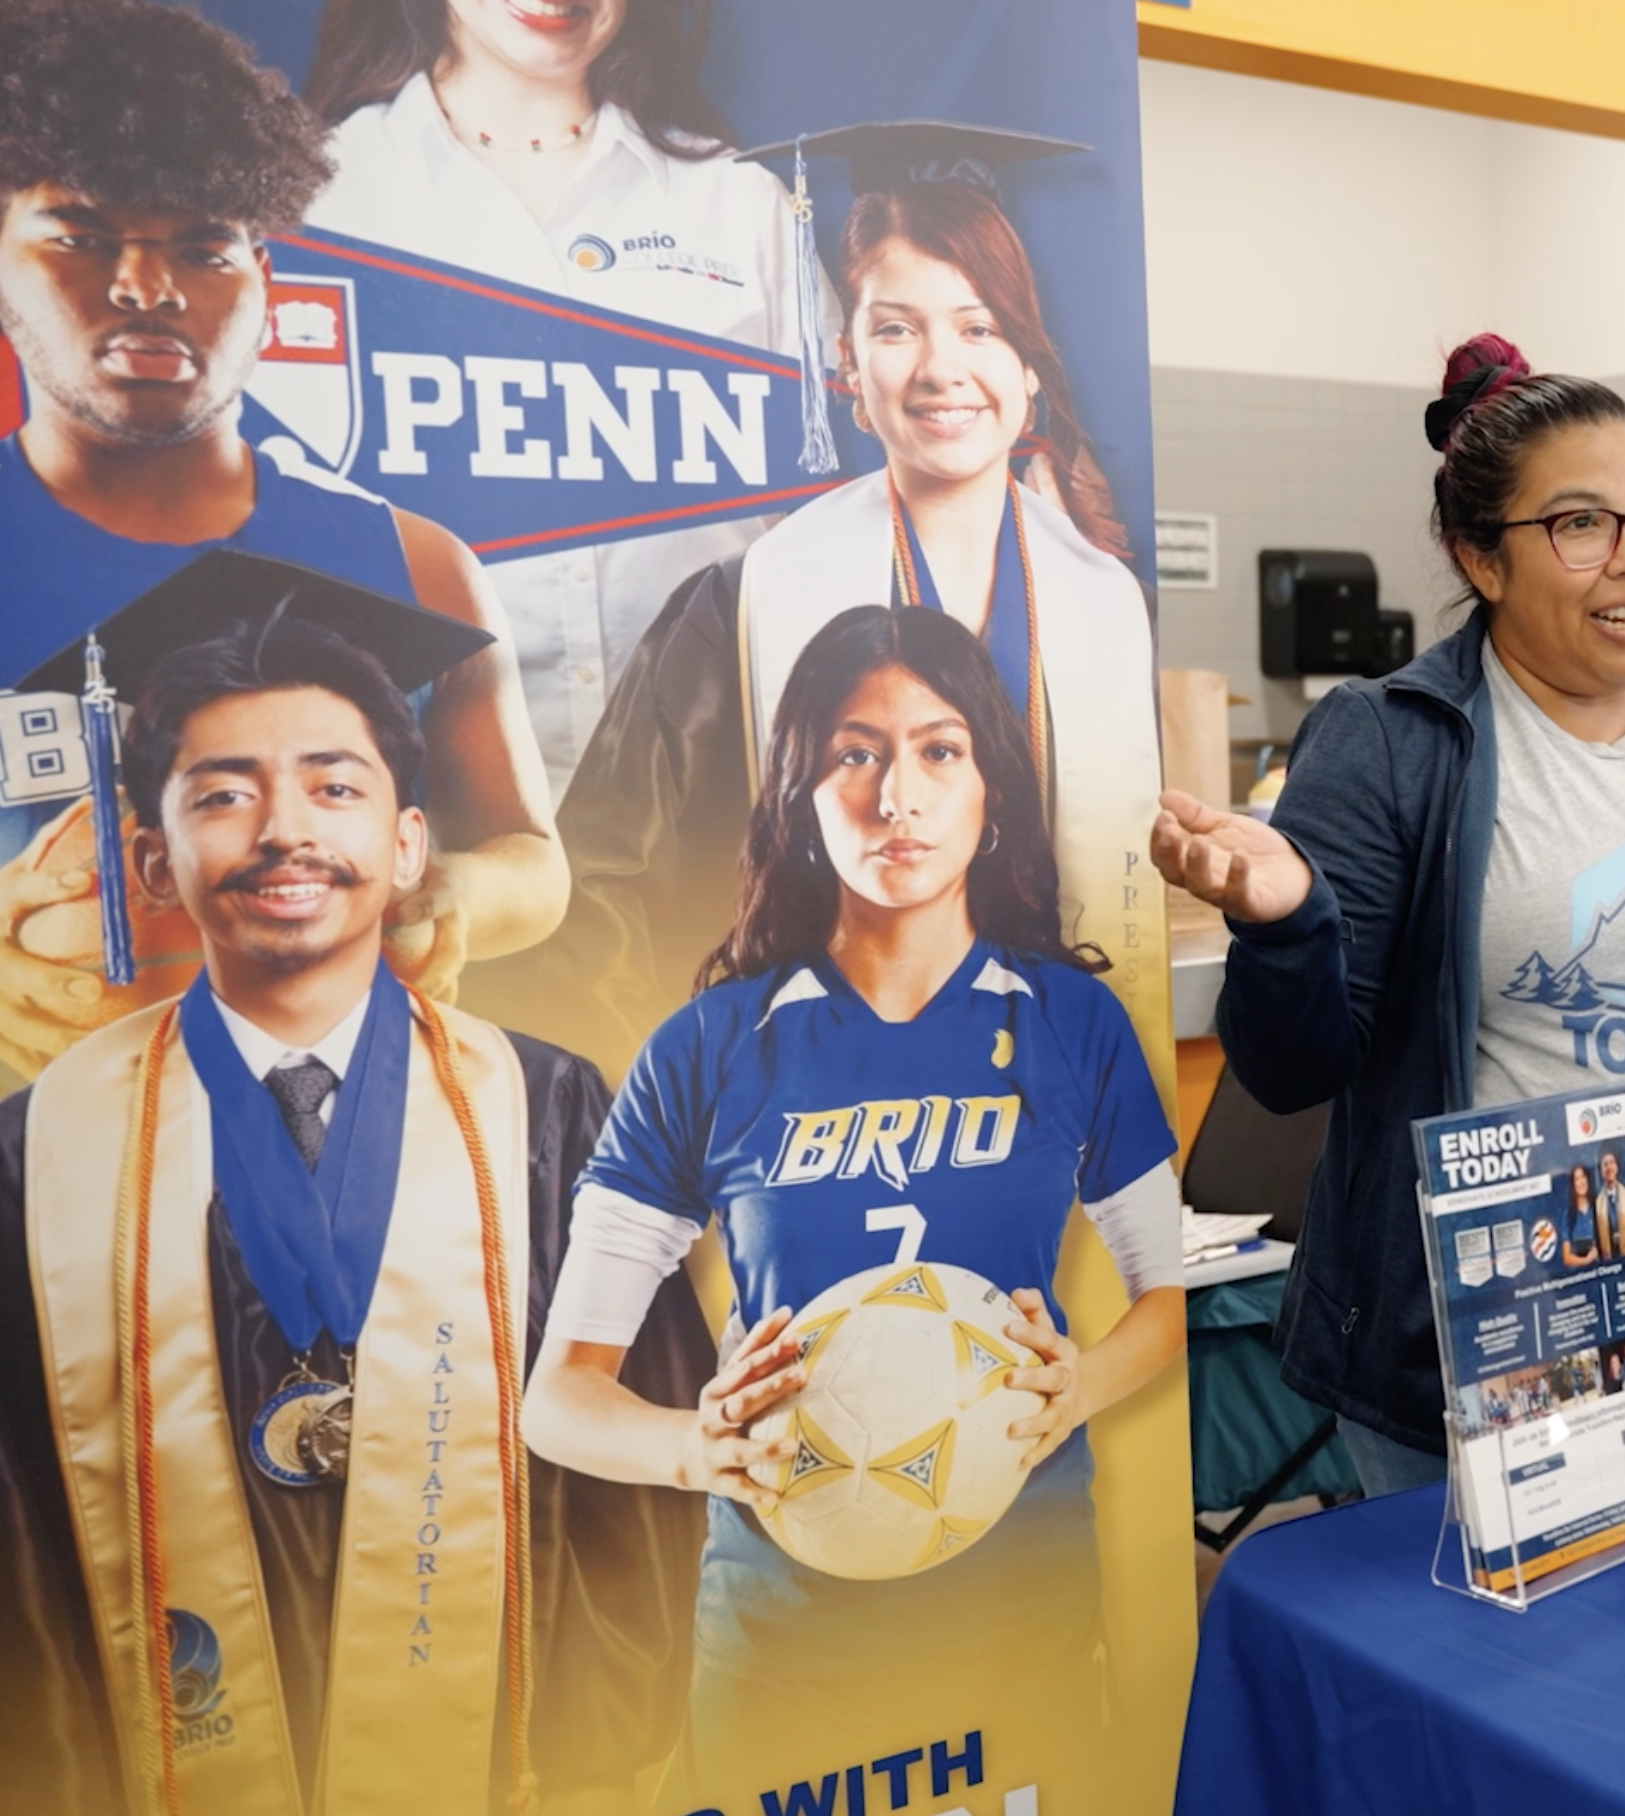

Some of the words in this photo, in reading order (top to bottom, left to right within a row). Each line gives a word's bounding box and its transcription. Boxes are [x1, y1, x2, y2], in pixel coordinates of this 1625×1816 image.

[371, 351, 772, 486] PENN
[764, 1095, 1021, 1191] BRIO
[1440, 1119, 1544, 1161] ENROLL
[1442, 1148, 1531, 1189] TODAY
[865, 1204, 927, 1263] 7
[408, 1322, 453, 1667] SALUTATORIAN
[173, 1714, 233, 1750] BRIO
[759, 1729, 984, 1816] WITH
